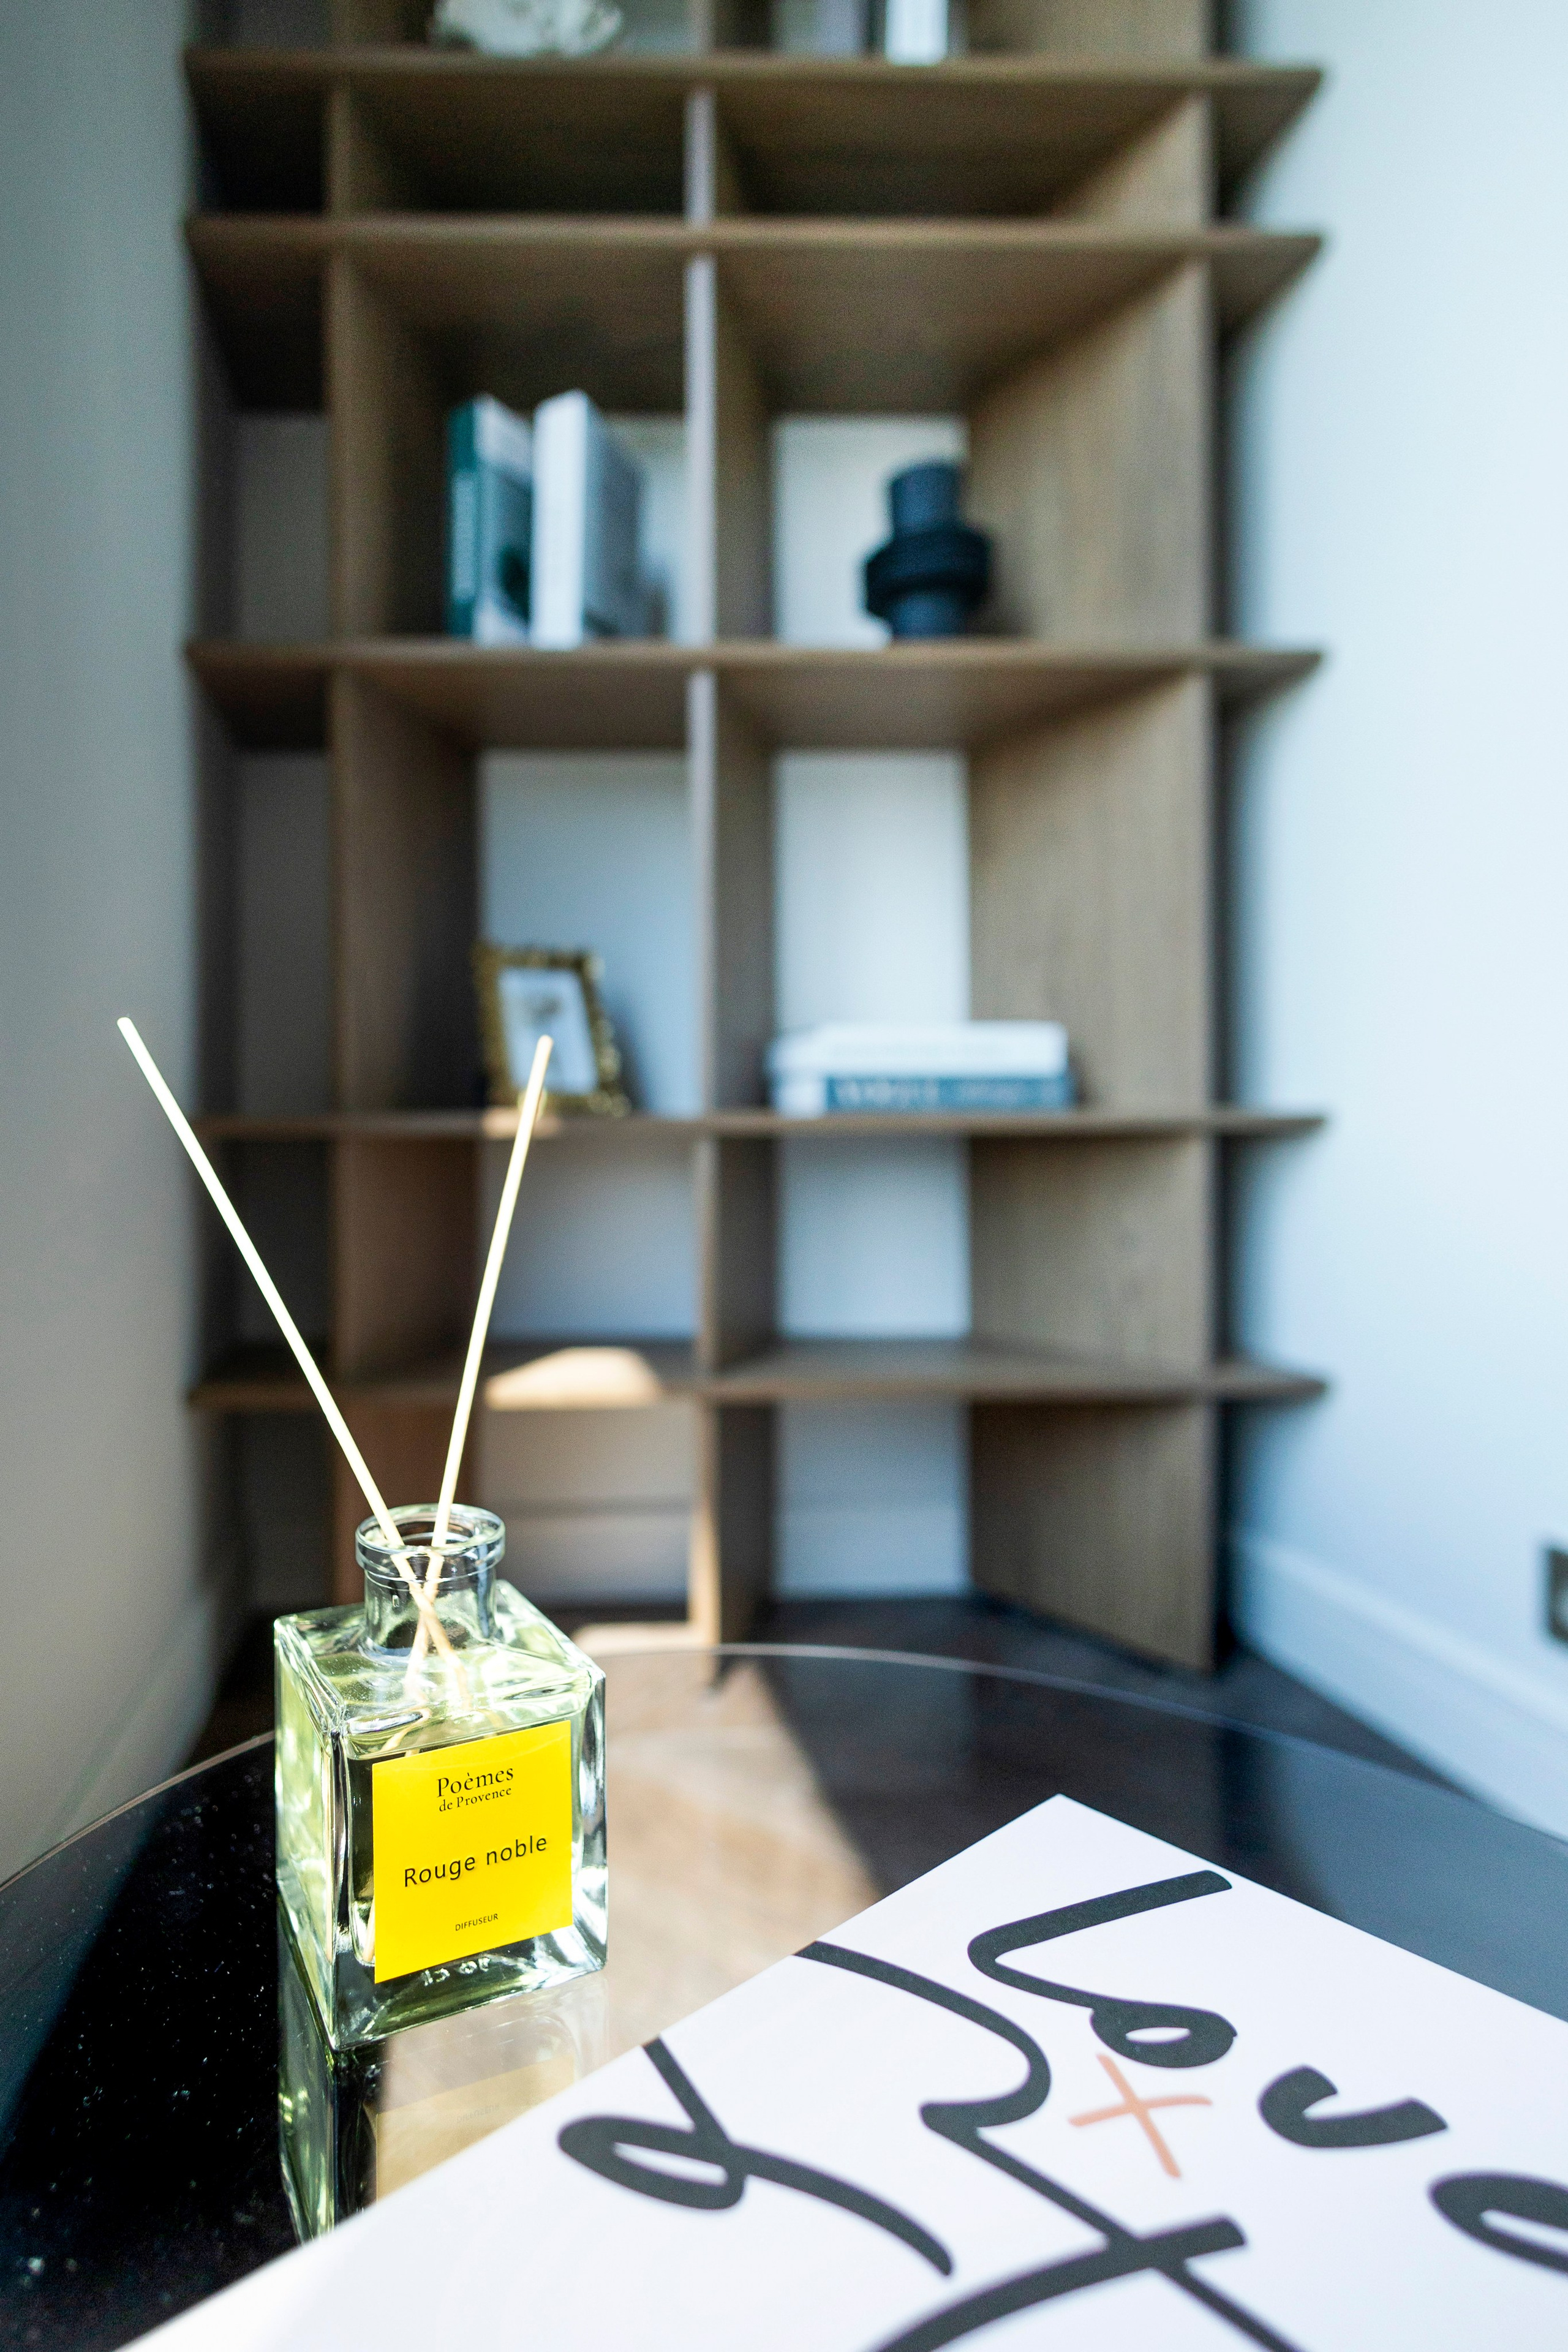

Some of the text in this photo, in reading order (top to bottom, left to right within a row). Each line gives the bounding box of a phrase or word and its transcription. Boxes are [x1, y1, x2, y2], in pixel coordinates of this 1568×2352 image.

[437, 1768, 514, 1798] Poèmes
[439, 1787, 512, 1812] de Provence
[404, 1835, 548, 1887] Rouge noble
[455, 1913, 499, 1932] DIFFUSEUR
